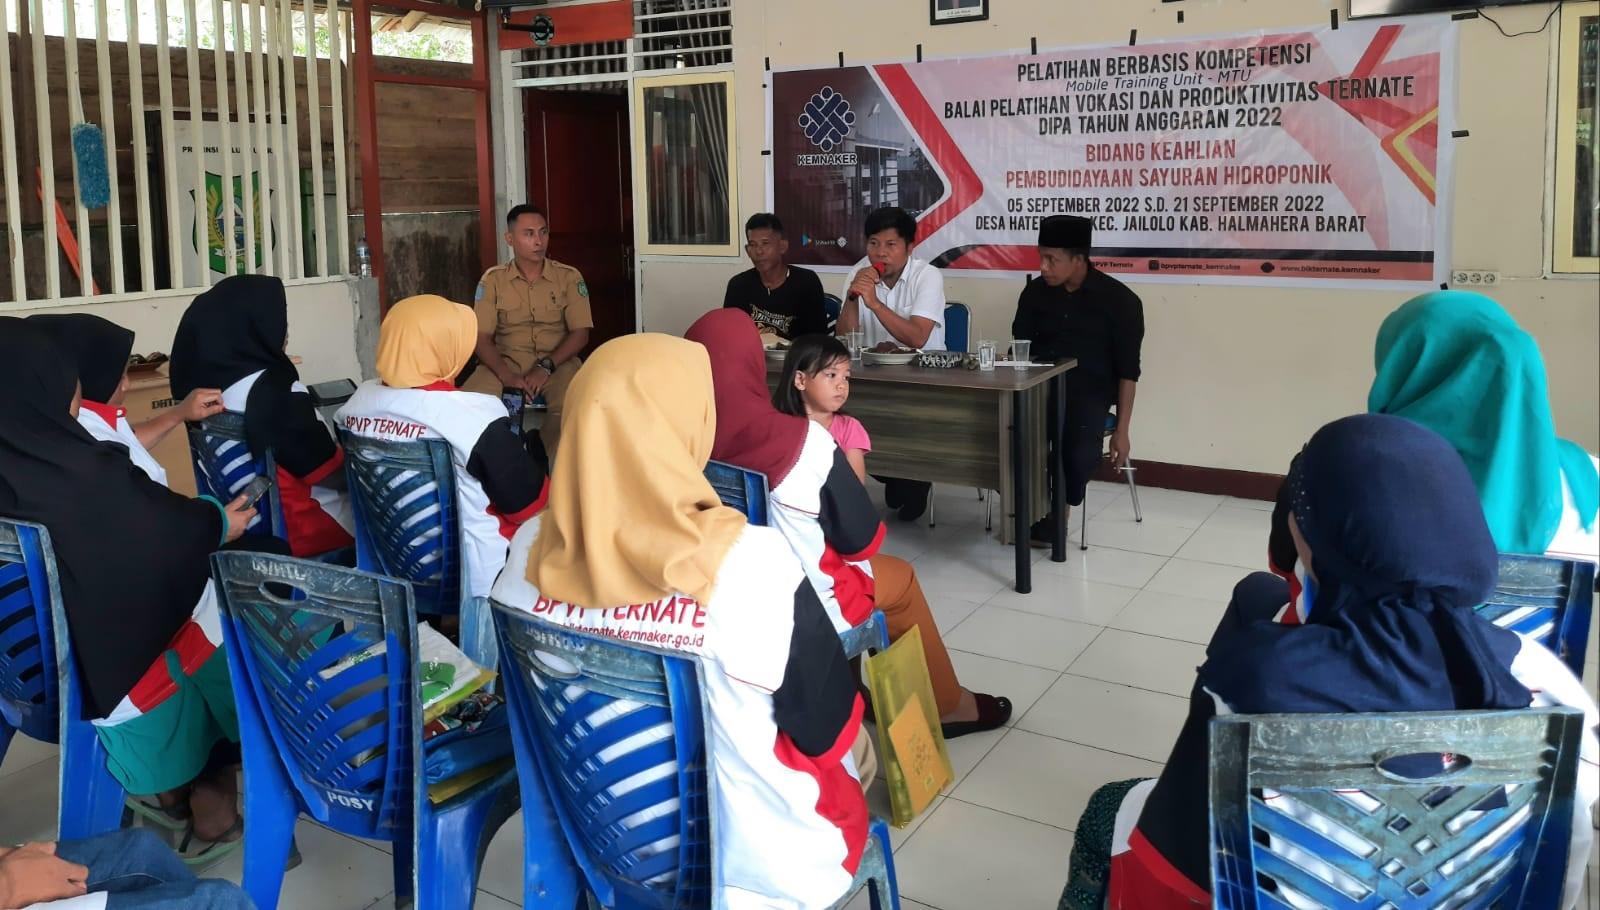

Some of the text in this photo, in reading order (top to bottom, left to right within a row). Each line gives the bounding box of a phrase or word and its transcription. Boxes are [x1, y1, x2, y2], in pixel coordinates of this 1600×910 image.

[1017, 43, 1312, 82] PELATIHAN BERBASIS KOMPETENSI
[1065, 79, 1109, 92] Mobile
[1114, 75, 1168, 90] Training
[1173, 73, 1203, 86] Unit
[1217, 69, 1252, 83] MTU
[944, 76, 1415, 119] BALAI PELATIHAN VOKASI DAN PRODUKTIVITAS TERNATE
[1039, 106, 1282, 135] DIPA TAHUN ANGGARAN 2022
[797, 153, 858, 166] KEMNAKER
[1086, 139, 1236, 162] BIDANG KEAHLIAN
[1006, 164, 1332, 188] PEMBUDIDAYAAN SAYURAN HIDROPONIK
[1007, 195, 1324, 213] 05 SEPTEMBER 2022 S.D. 21 SEPTEMBER 2022
[975, 215, 1006, 231] DESA
[1090, 215, 1119, 231] KEC.
[1123, 215, 1175, 232] JAILOLO
[1180, 215, 1213, 232] KAB.
[1218, 215, 1310, 232] HALMAHERA
[1315, 215, 1367, 233] BARAT
[326, 790, 373, 812] POSY
